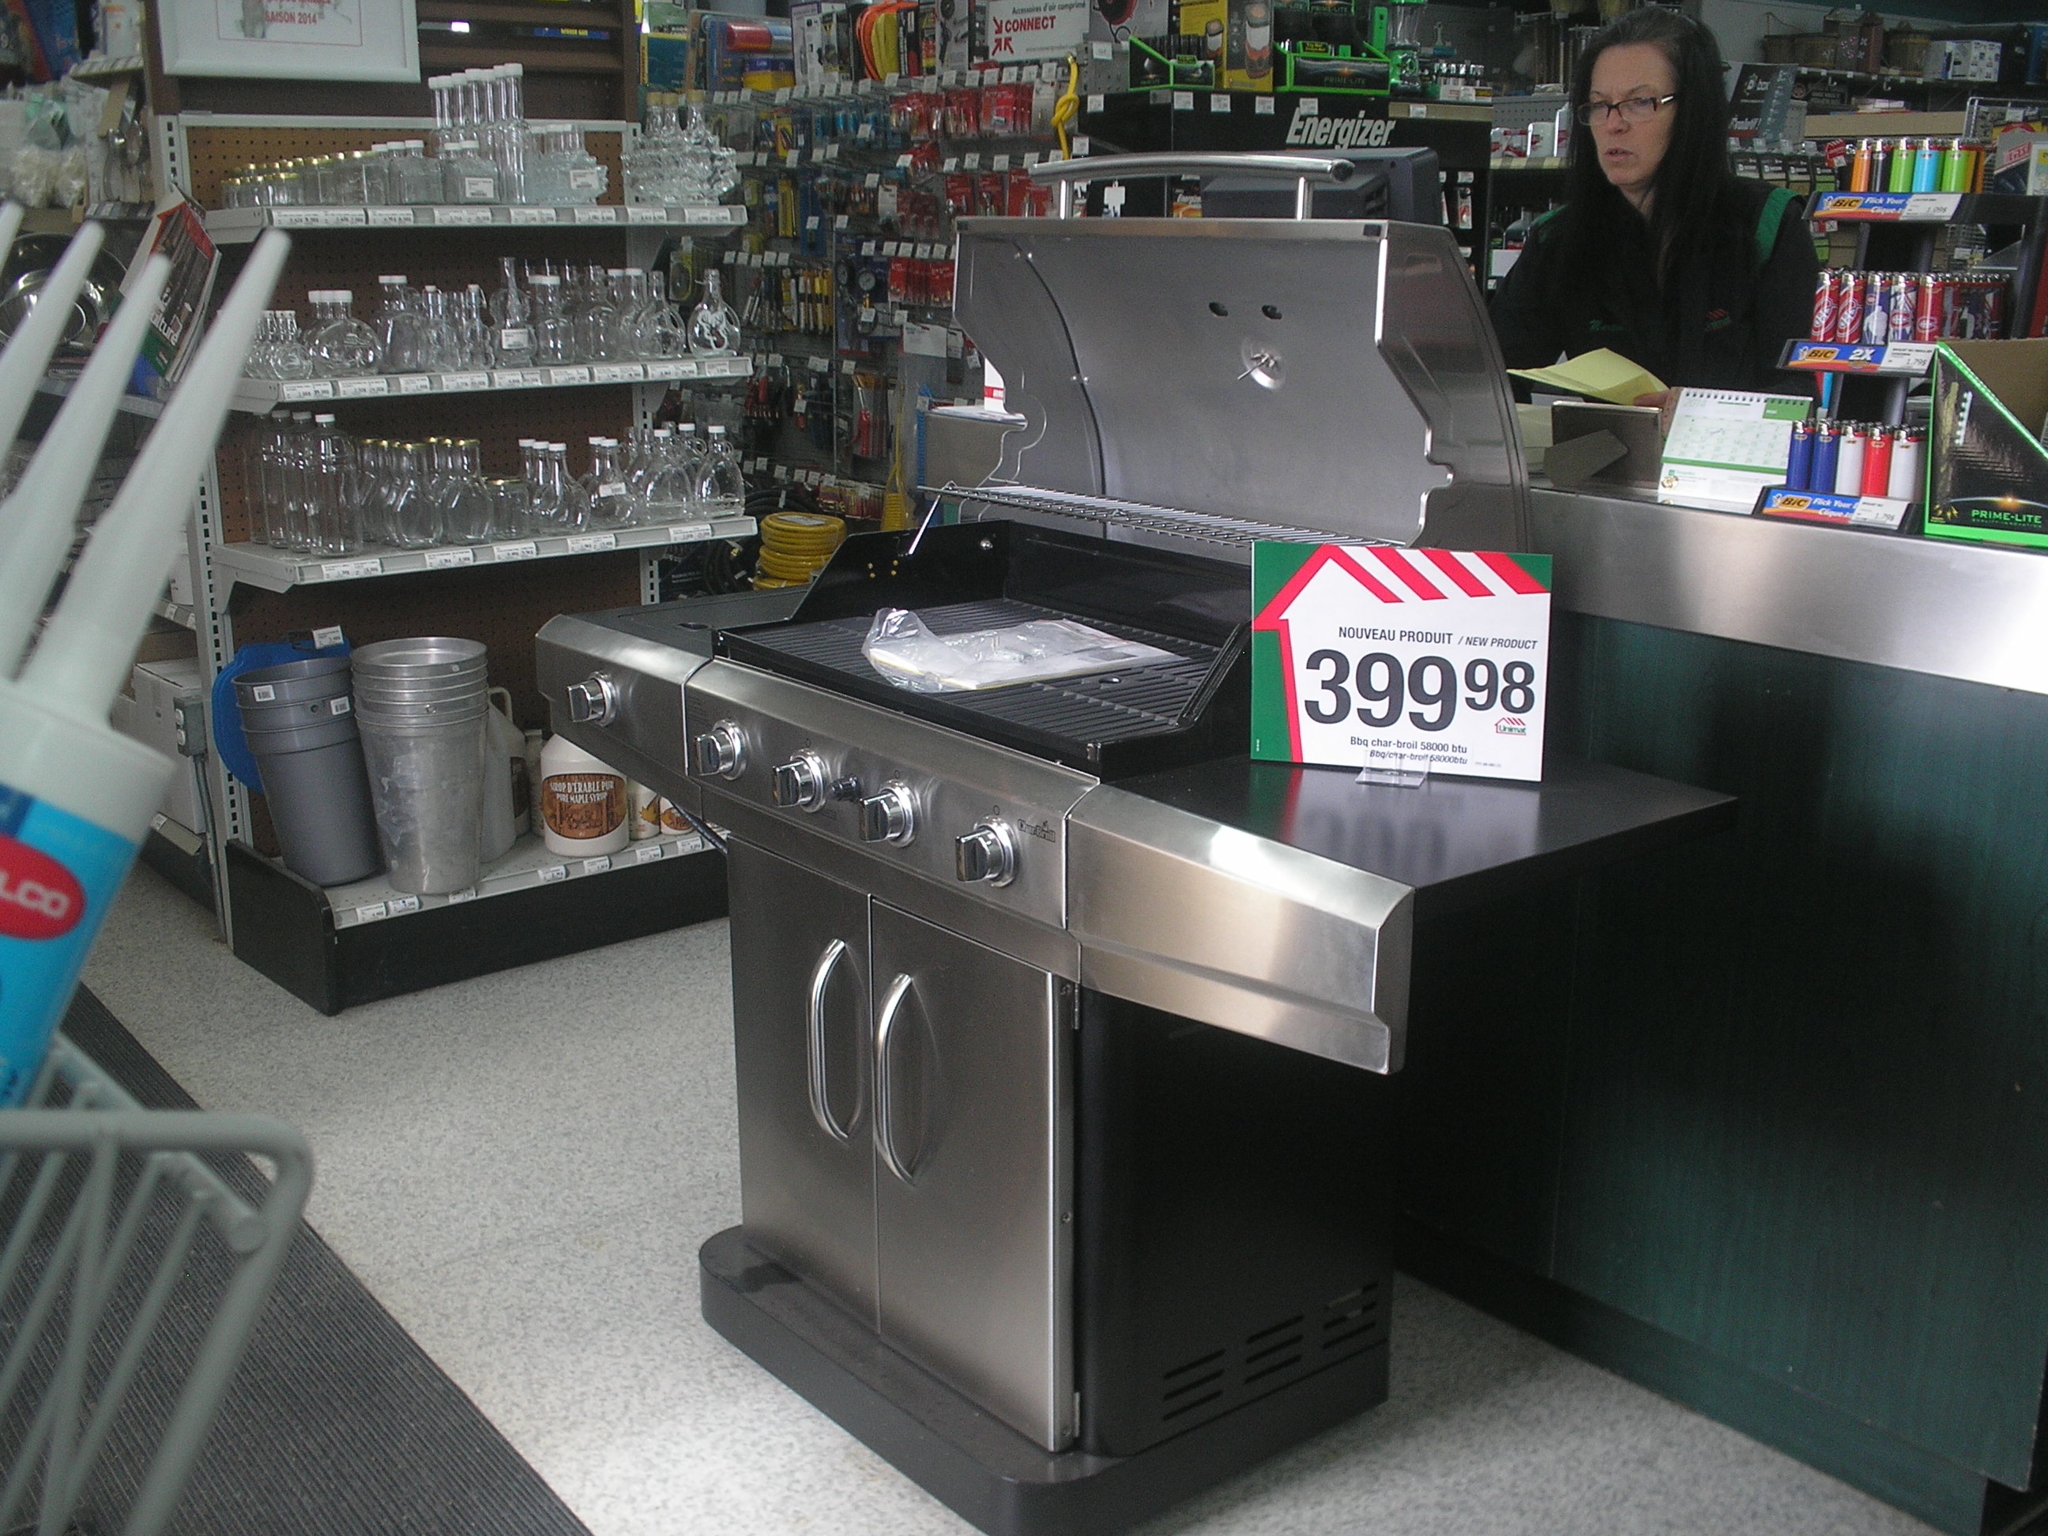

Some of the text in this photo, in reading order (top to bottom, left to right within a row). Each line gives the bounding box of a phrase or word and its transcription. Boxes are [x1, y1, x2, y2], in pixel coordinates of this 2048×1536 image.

[265, 11, 318, 25] SAISON 2014
[1005, 16, 1056, 33] CONNECT
[1286, 107, 1396, 149] Energizer
[1865, 197, 1884, 205] Flick
[1849, 349, 1876, 361] 2X
[1971, 509, 2042, 524] PRIME-LITE
[1338, 626, 1395, 641] NOUVEAU
[1399, 629, 1453, 645] PRODUIT
[1466, 636, 1488, 647] NEW
[1490, 637, 1538, 650] PRODUCT
[1498, 725, 1527, 734] Unimat
[1350, 736, 1468, 754] Bbq char-broil 58000 btu
[602, 781, 614, 791] PUR
